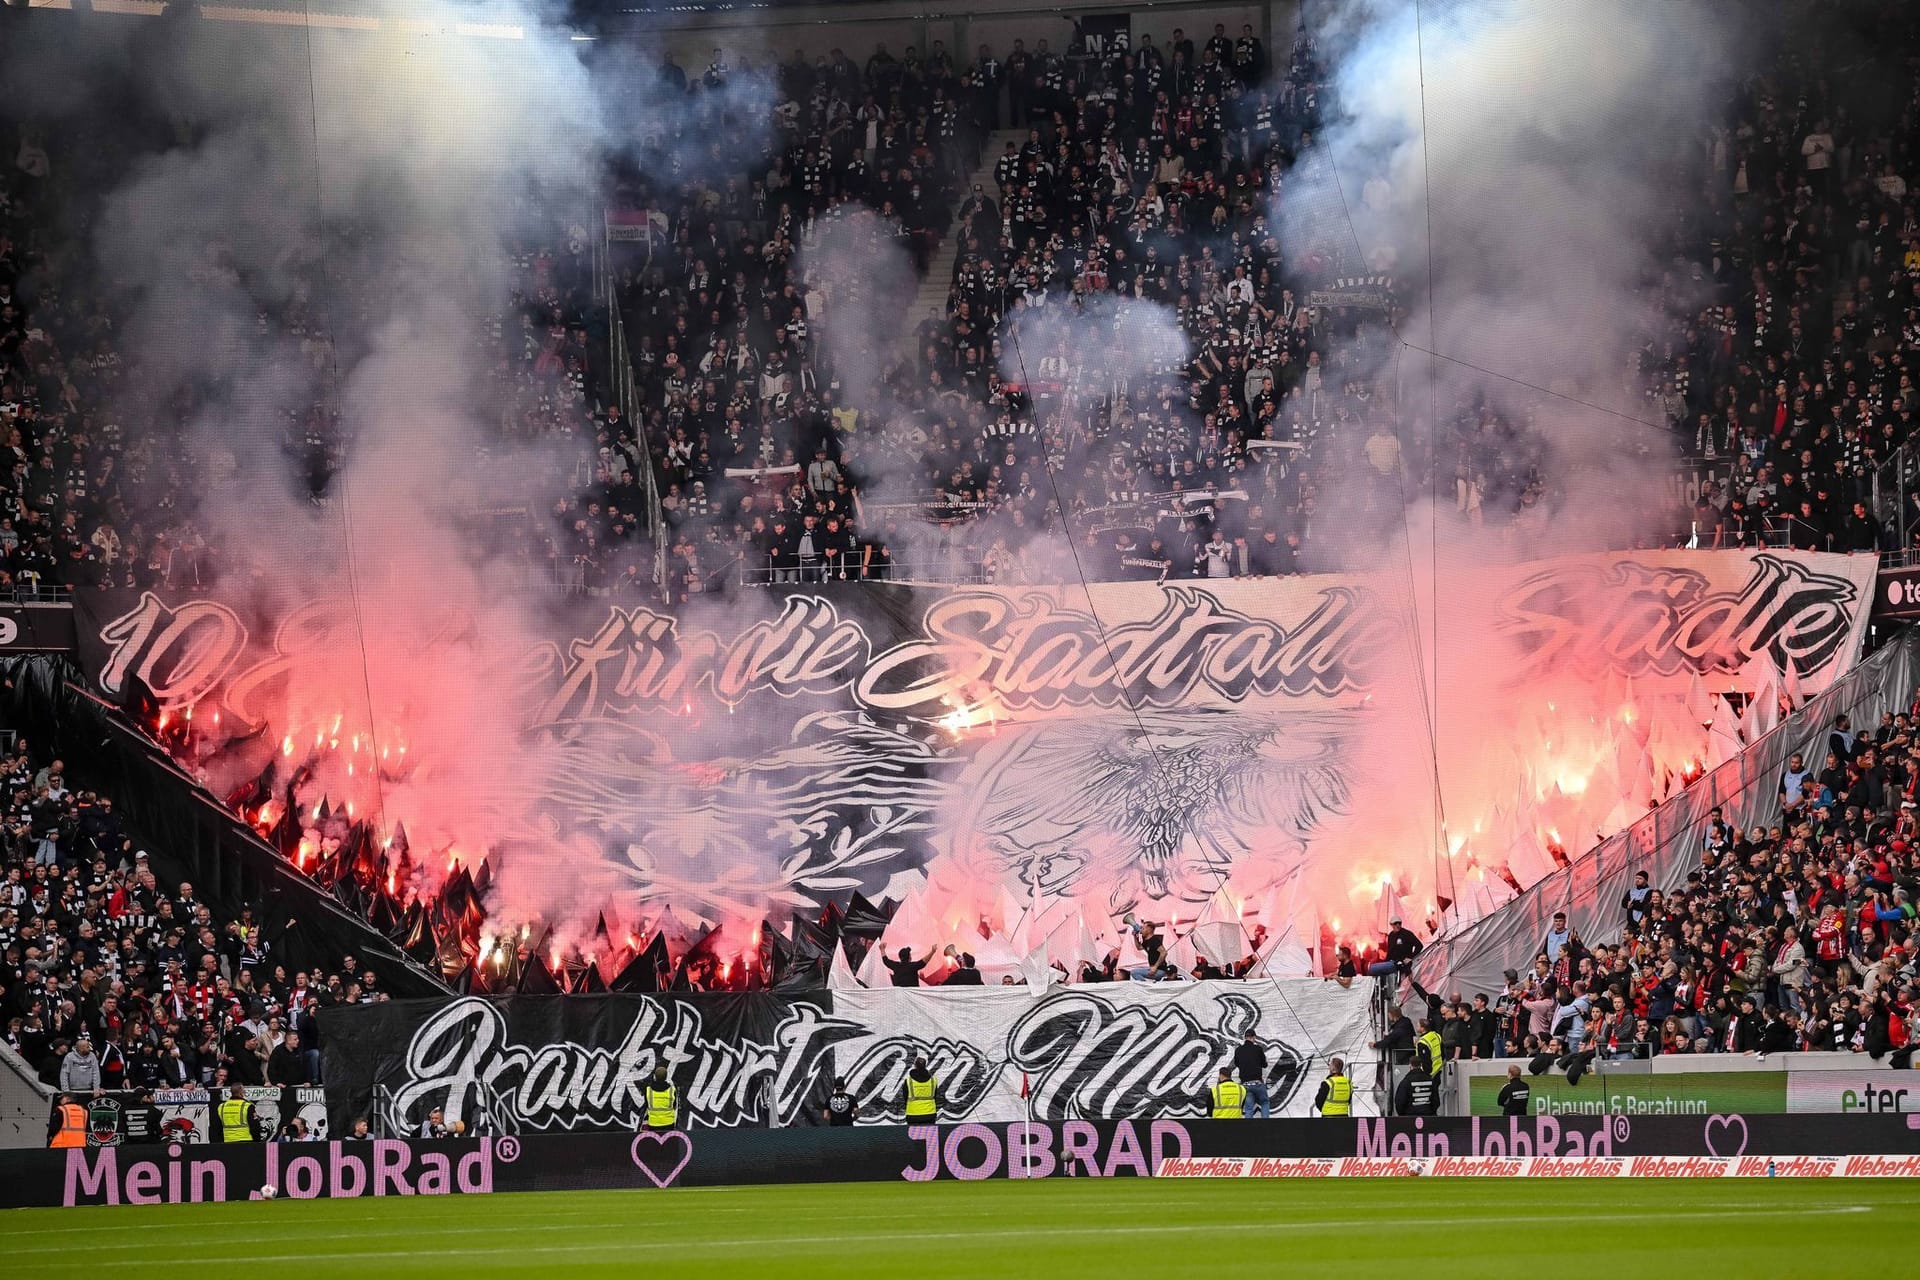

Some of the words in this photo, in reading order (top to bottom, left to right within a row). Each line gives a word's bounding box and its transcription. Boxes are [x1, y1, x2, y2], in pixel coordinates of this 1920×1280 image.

[100, 591, 248, 710] 10
[712, 594, 873, 705] die
[390, 995, 872, 1135] Frankfurt
[838, 1034, 1003, 1124] am
[1611, 1095, 1622, 1115] &
[901, 1119, 1192, 1181] JOBRAD
[63, 1146, 227, 1207] Mein
[1161, 1158, 1244, 1177] WeberHaus
[1250, 1158, 1334, 1177] WeberHaus
[1432, 1157, 1522, 1177] WeberHaus
[1527, 1157, 1624, 1177] WeberHaus
[1630, 1157, 1729, 1177] WeberHaus
